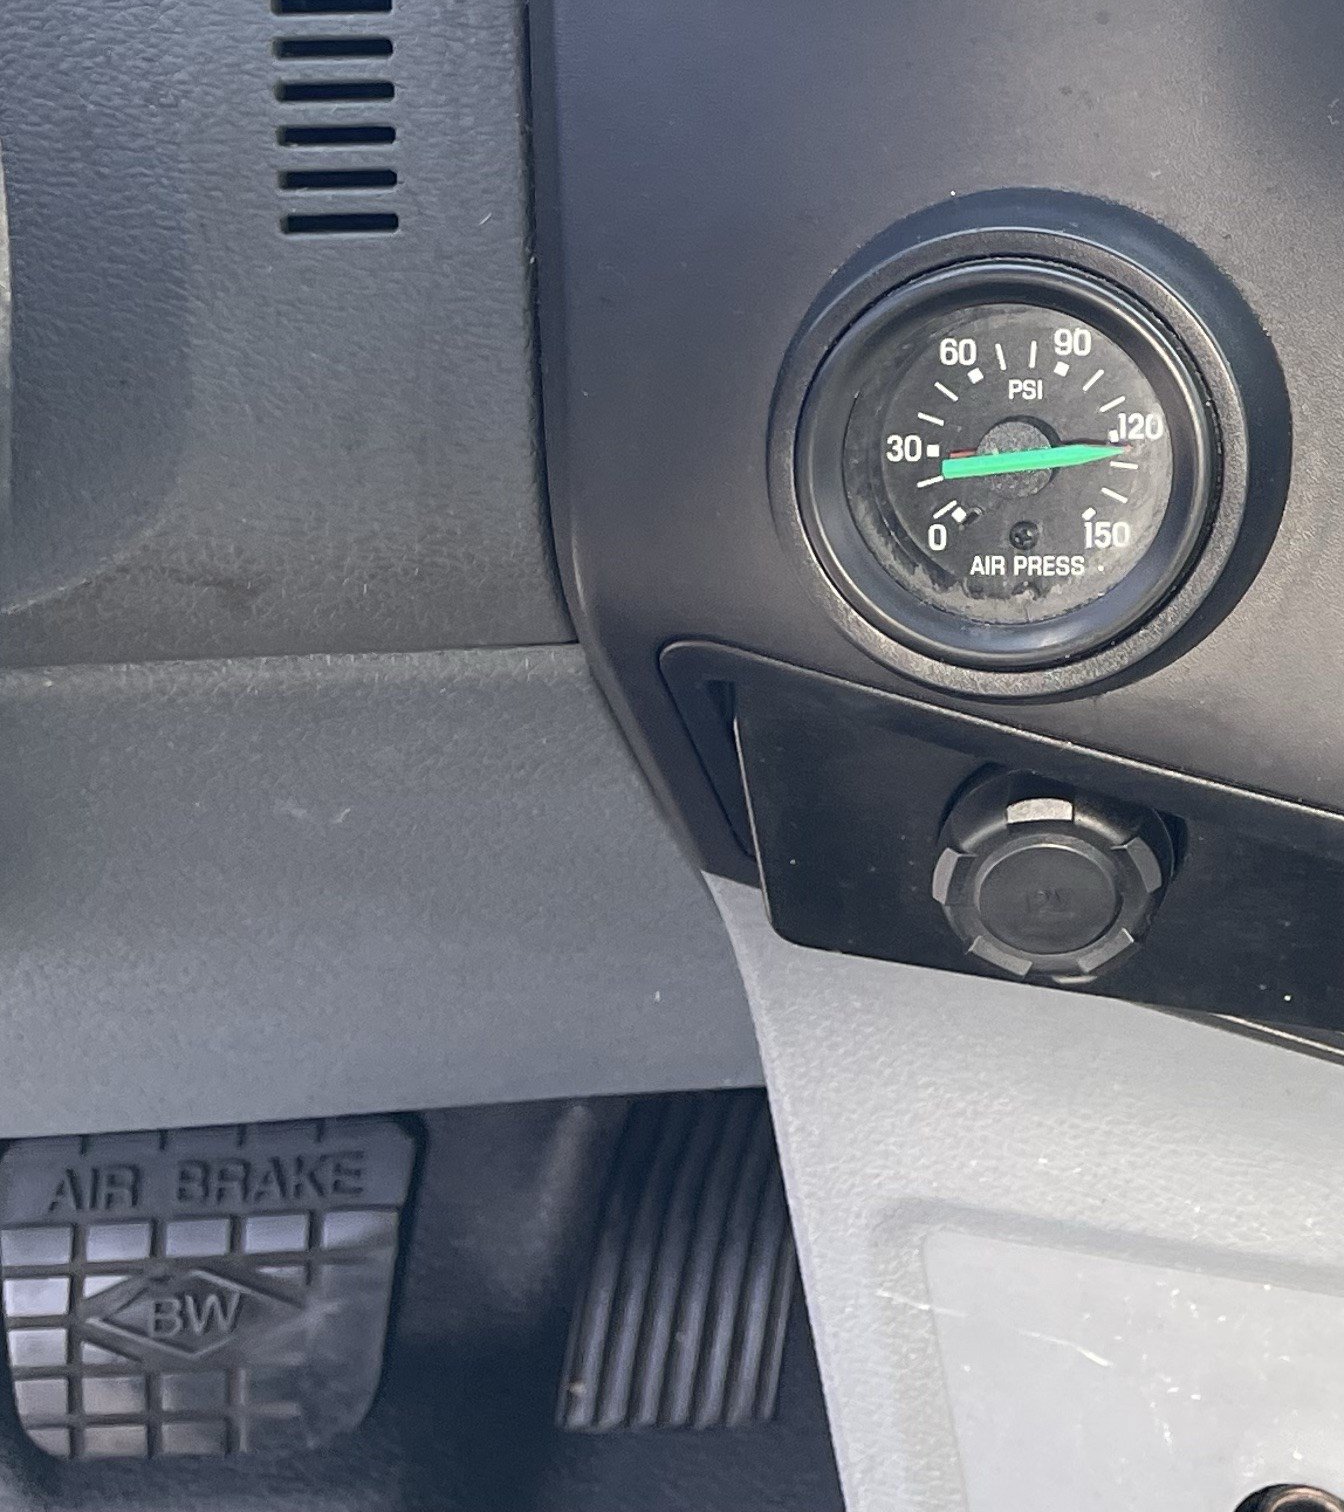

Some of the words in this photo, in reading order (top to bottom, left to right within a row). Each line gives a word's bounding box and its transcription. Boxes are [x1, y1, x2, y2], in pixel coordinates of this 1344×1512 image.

[939, 338, 977, 366] 60
[1053, 328, 1092, 356] 90
[1008, 380, 1043, 401] PSI
[1117, 413, 1163, 440] 120
[886, 434, 922, 463] 30
[928, 523, 947, 551] 0
[1084, 520, 1130, 549] 150
[969, 555, 1006, 576] AIR
[1013, 555, 1085, 576] PRESS
[50, 1162, 142, 1213] AIR
[177, 1148, 367, 1205] BRAKE
[147, 1291, 242, 1338] BW
